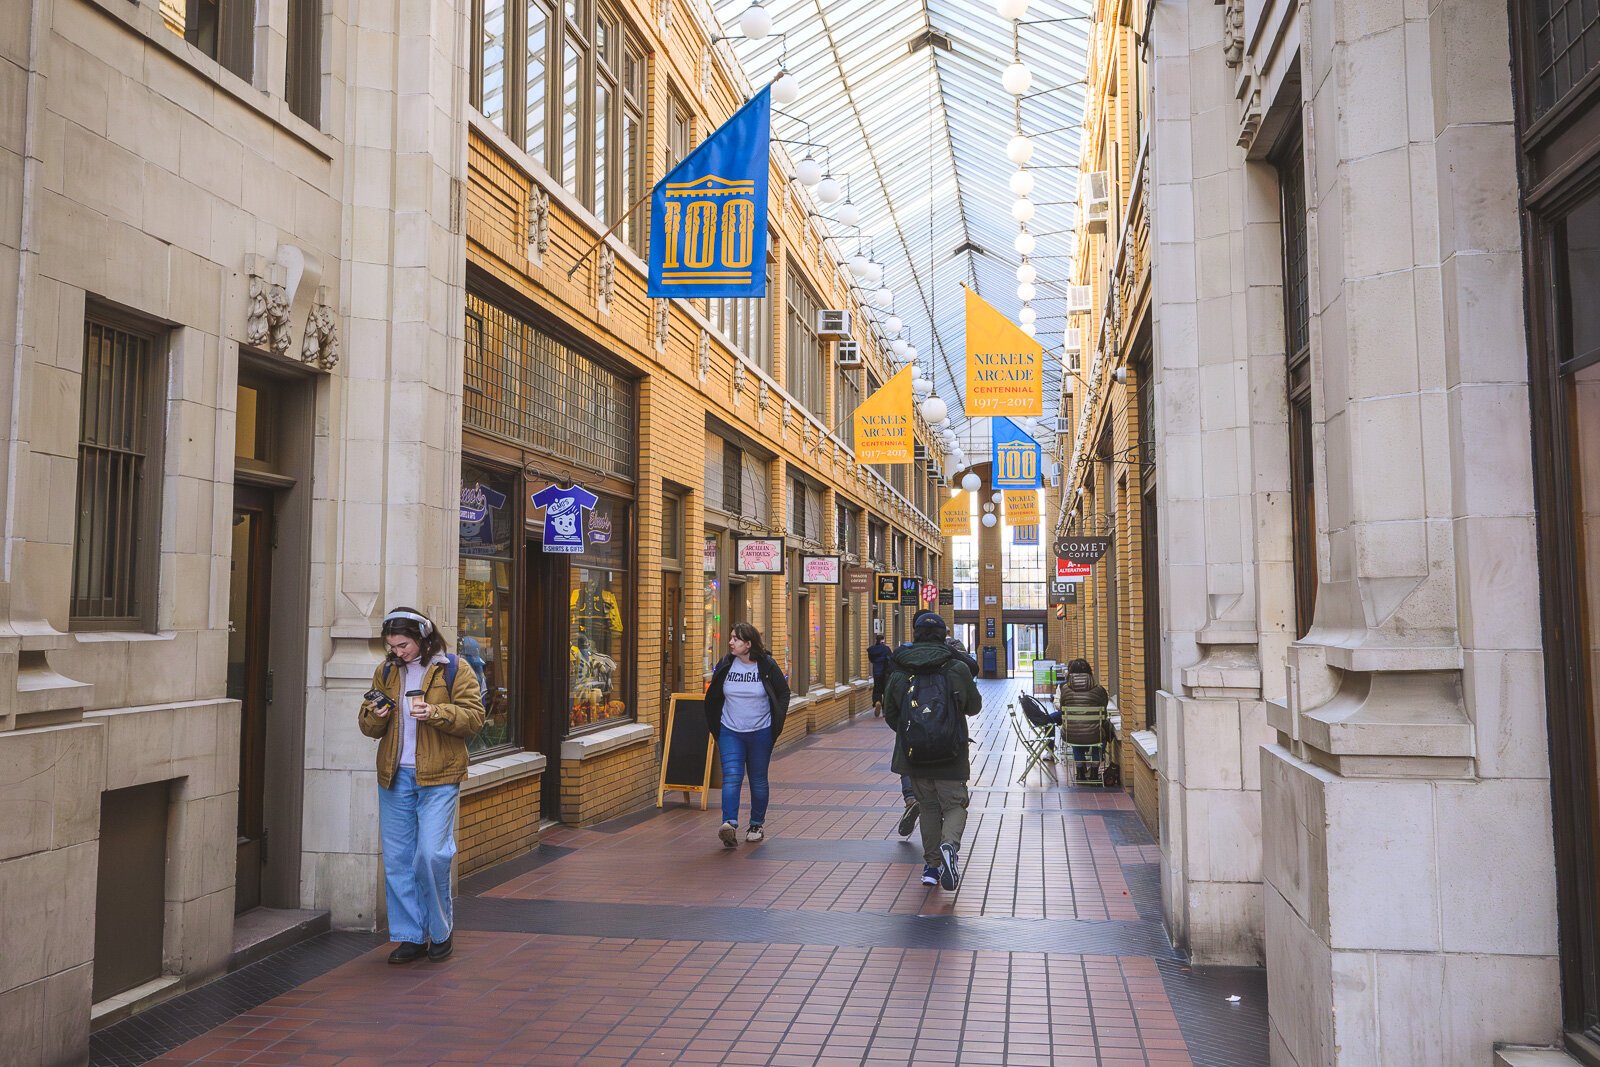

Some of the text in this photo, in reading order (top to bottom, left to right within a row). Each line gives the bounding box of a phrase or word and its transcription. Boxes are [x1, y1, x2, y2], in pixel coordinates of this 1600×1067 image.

[662, 199, 754, 268] 100
[974, 353, 1034, 365] NICKELS
[974, 369, 1034, 381] ARCADE
[861, 415, 907, 425] NICKELS
[861, 427, 907, 437] ARCADE
[997, 450, 1037, 479] 100
[1007, 494, 1036, 502] NICKELS
[551, 499, 570, 512] ELMO'S
[1008, 503, 1035, 511] ARCADE
[1061, 543, 1106, 551] COMET
[1051, 580, 1075, 593] ten
